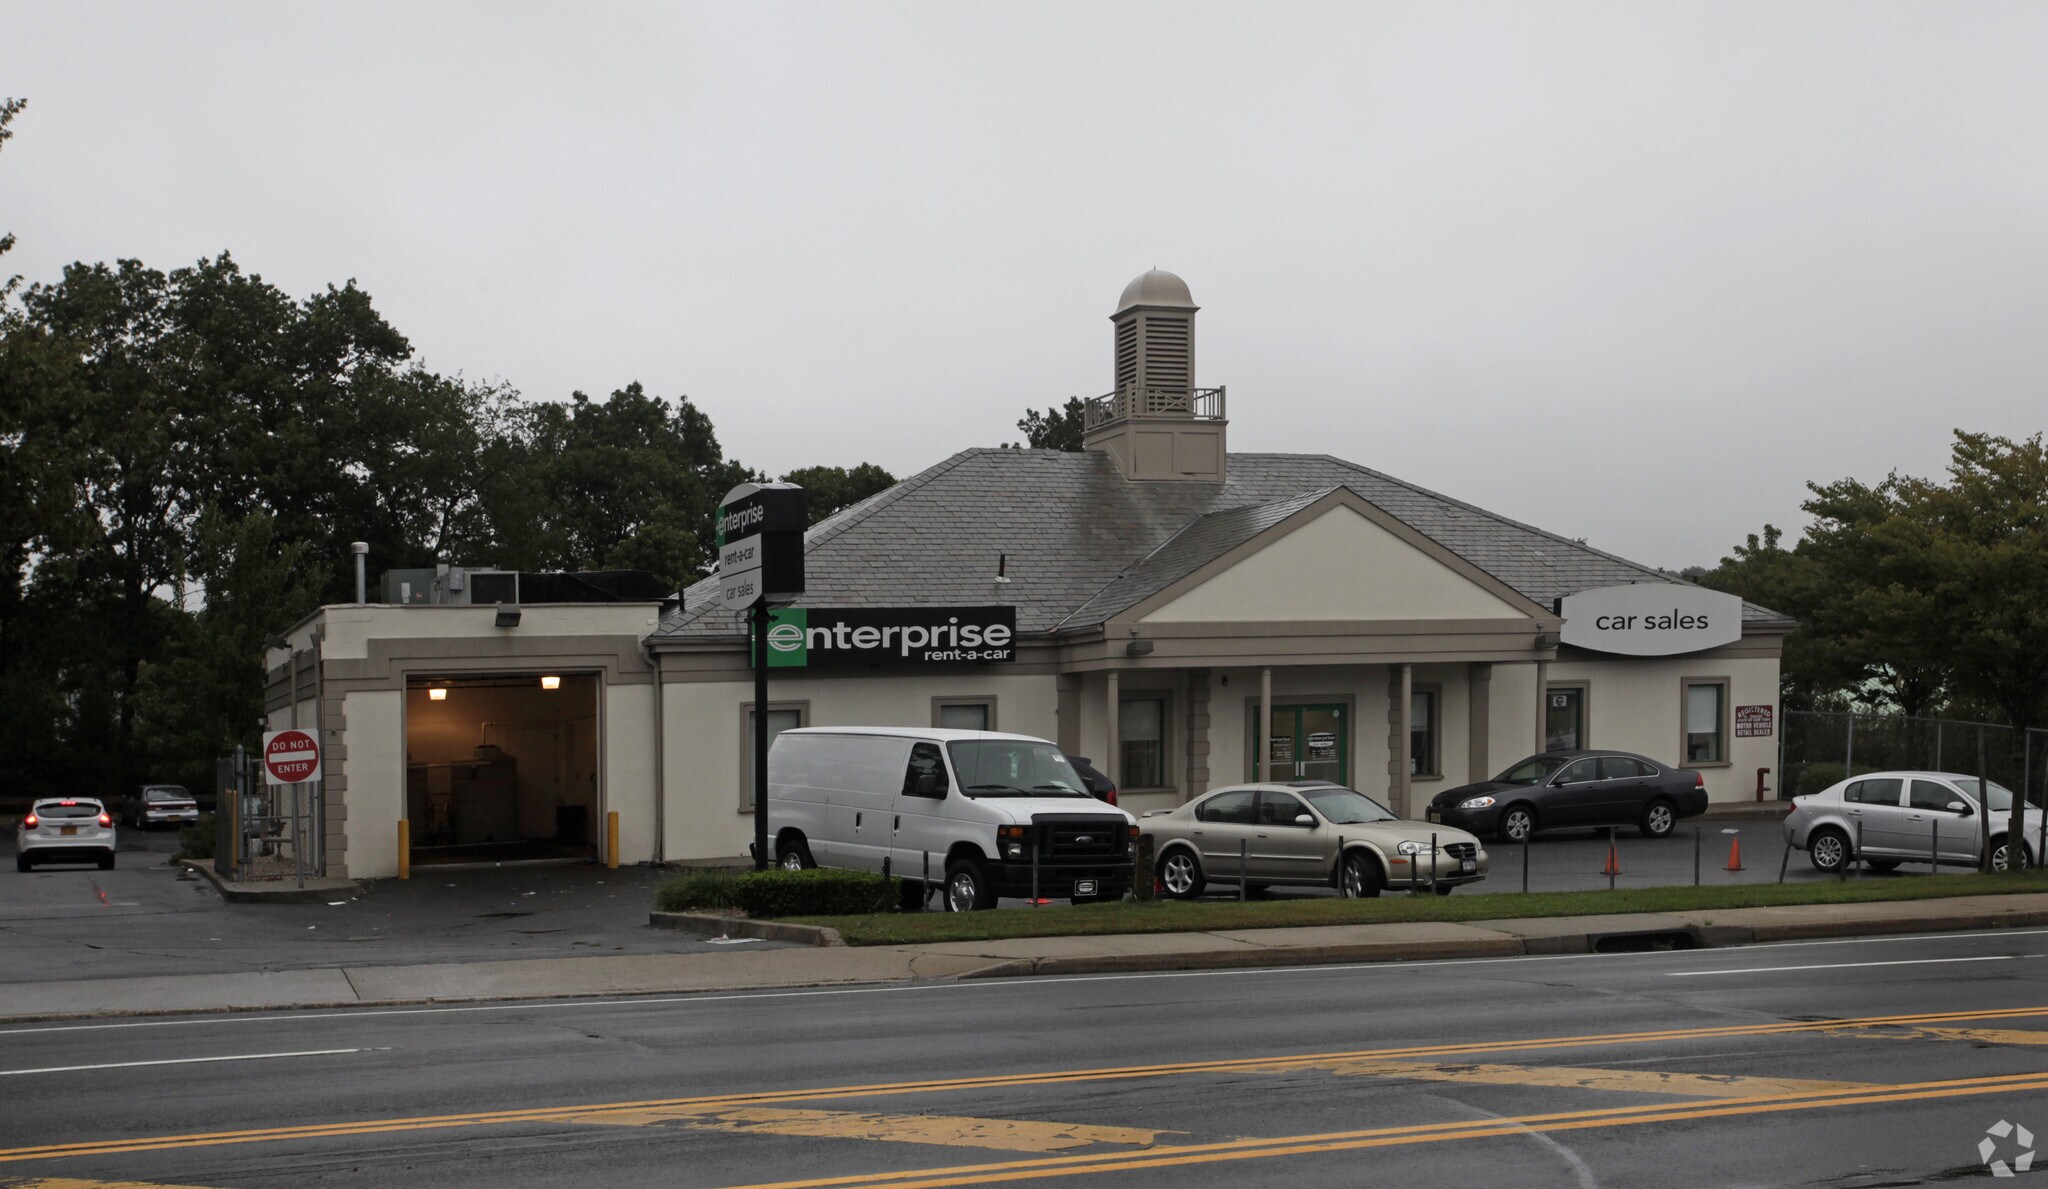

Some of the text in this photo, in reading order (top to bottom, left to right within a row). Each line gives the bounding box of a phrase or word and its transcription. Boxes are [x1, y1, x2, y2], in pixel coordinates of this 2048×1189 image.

[716, 502, 764, 535] enterprise
[724, 546, 754, 566] rent-a-car
[726, 579, 754, 600] car sales
[1596, 608, 1709, 630] car sales
[767, 617, 1011, 657] enterprise
[924, 649, 1011, 661] rent-a-car
[272, 740, 310, 751] DO NOT
[278, 763, 308, 773] ENTER
